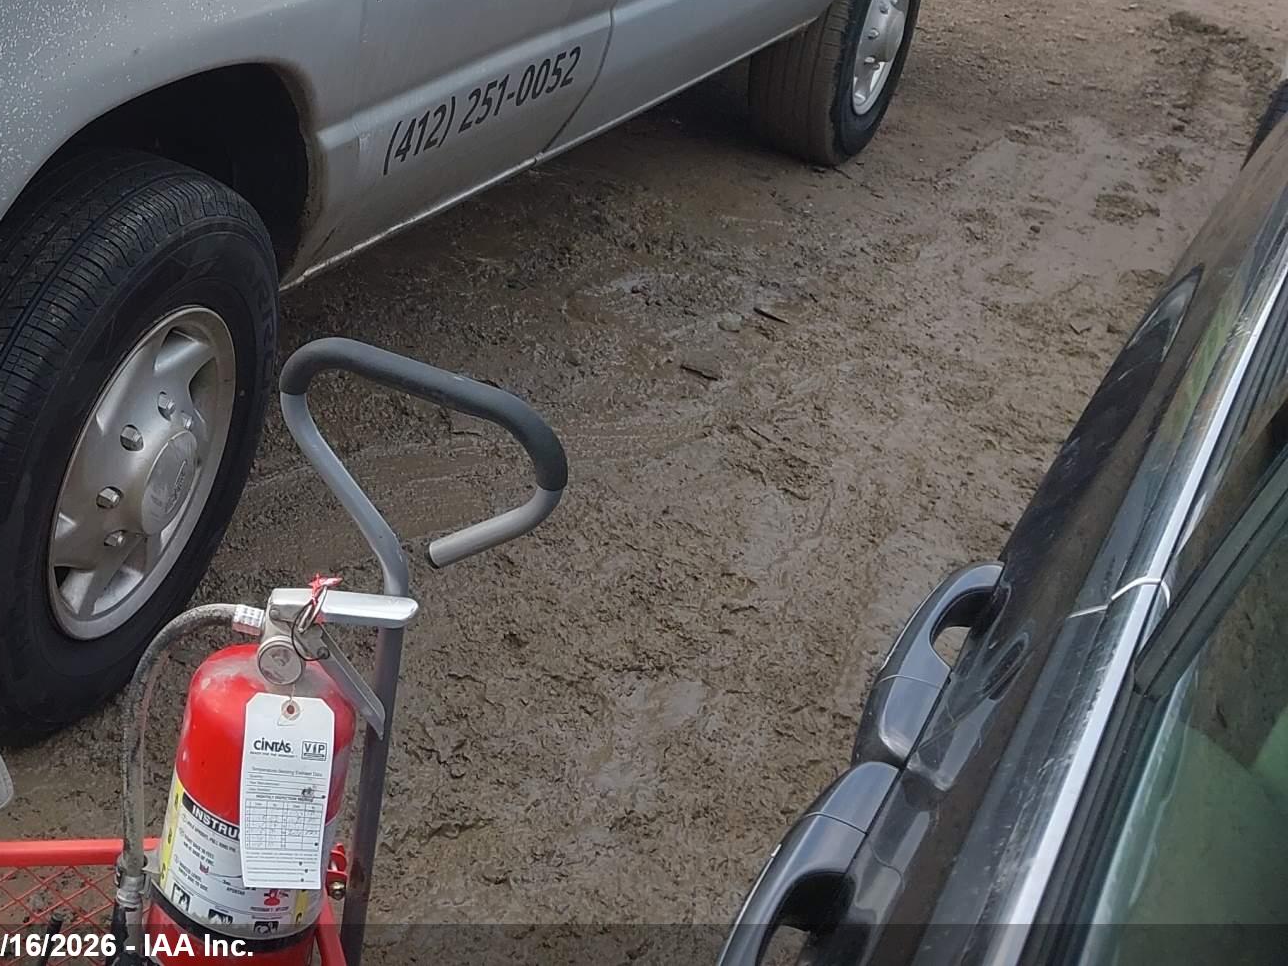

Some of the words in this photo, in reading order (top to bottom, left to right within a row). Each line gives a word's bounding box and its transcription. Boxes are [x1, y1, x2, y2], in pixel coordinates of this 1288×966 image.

[382, 96, 457, 176] (412)
[458, 46, 582, 135] 251-0052
[304, 742, 326, 755] VIP
[192, 804, 241, 840] INSTRU
